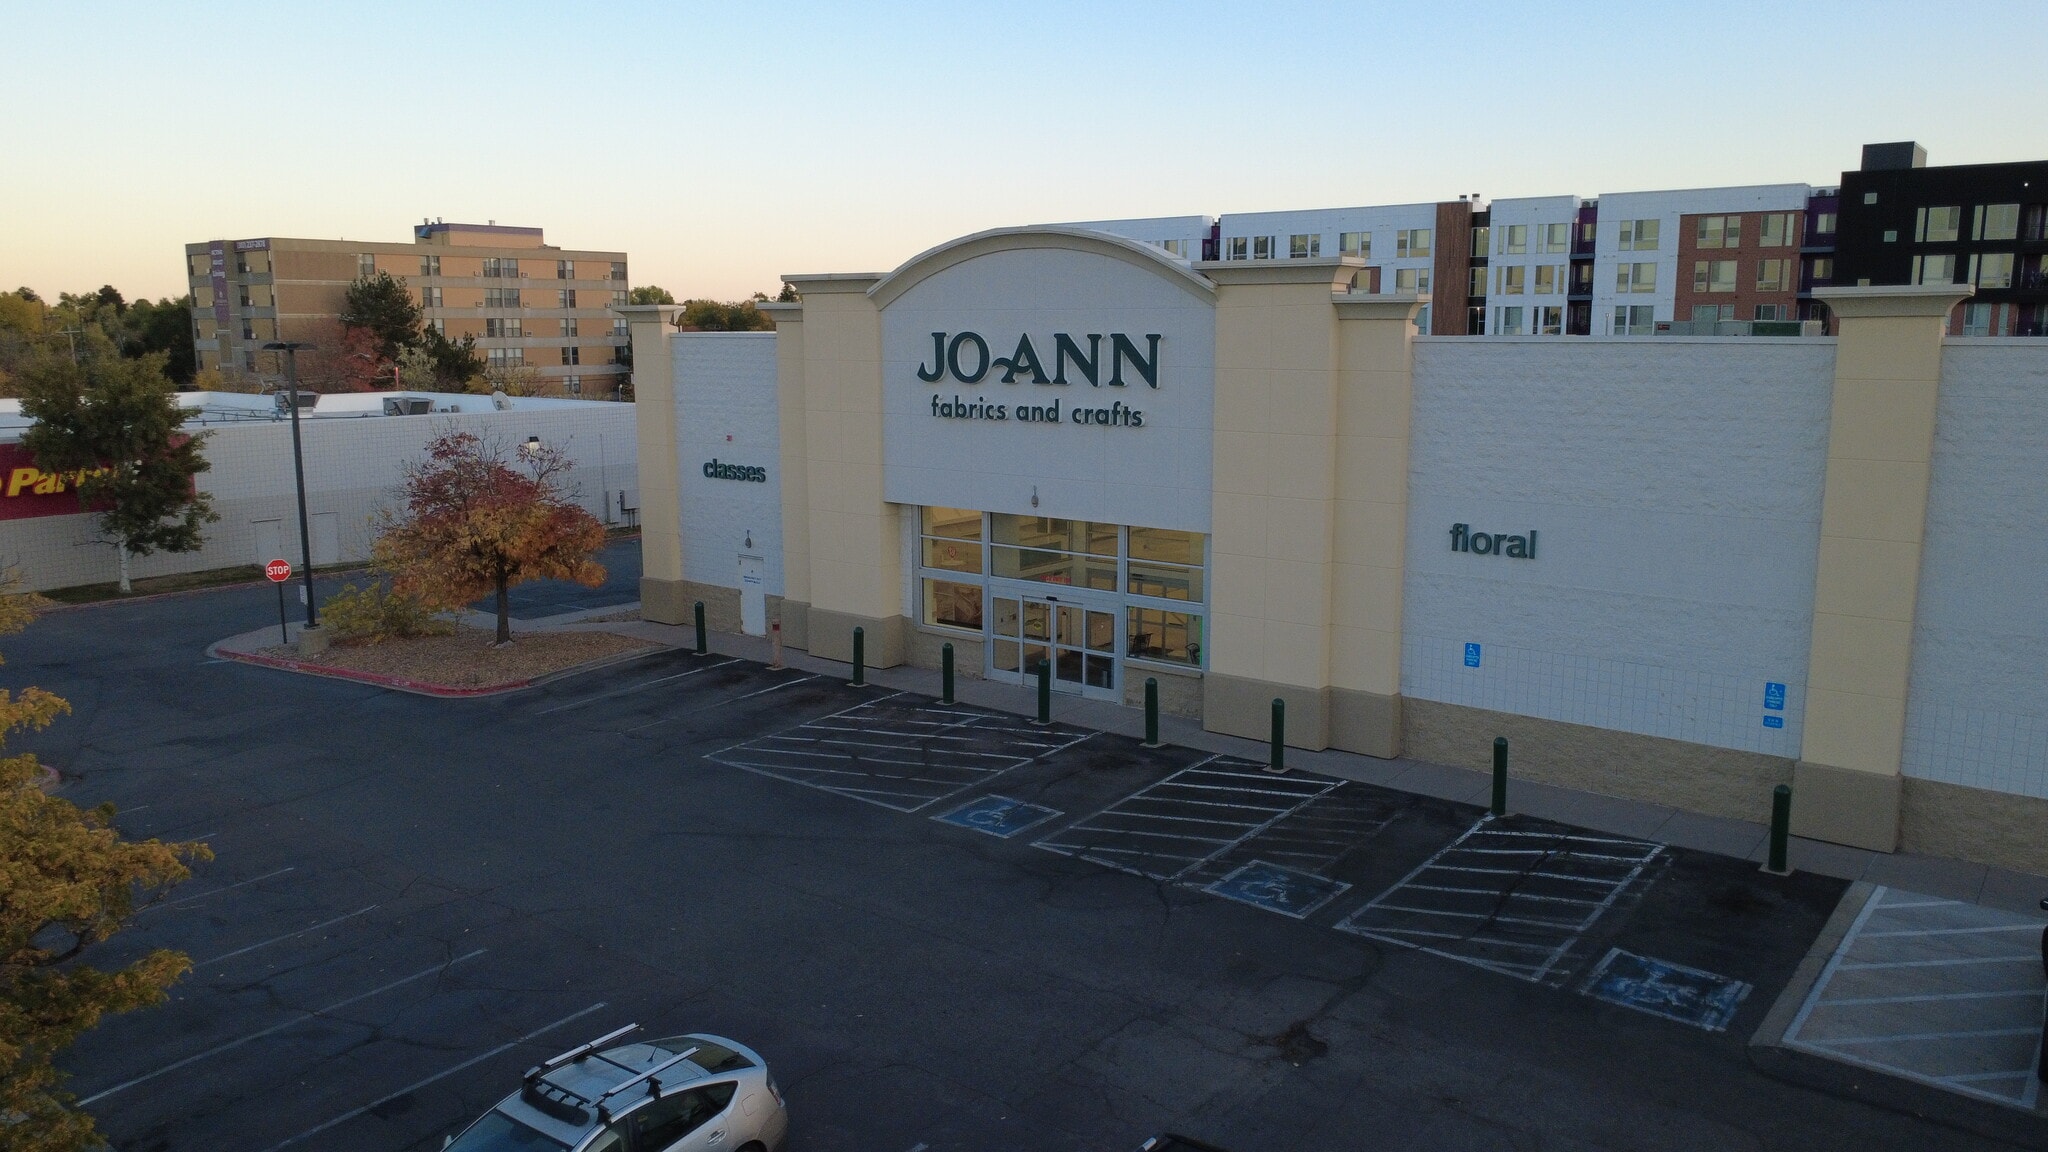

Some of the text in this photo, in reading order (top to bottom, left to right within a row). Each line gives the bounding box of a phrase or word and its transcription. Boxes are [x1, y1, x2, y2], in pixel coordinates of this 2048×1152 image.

[931, 394, 1145, 427] fabrics and crafts
[702, 458, 766, 483] classes
[1449, 522, 1538, 560] floral
[268, 565, 289, 576] STOP
